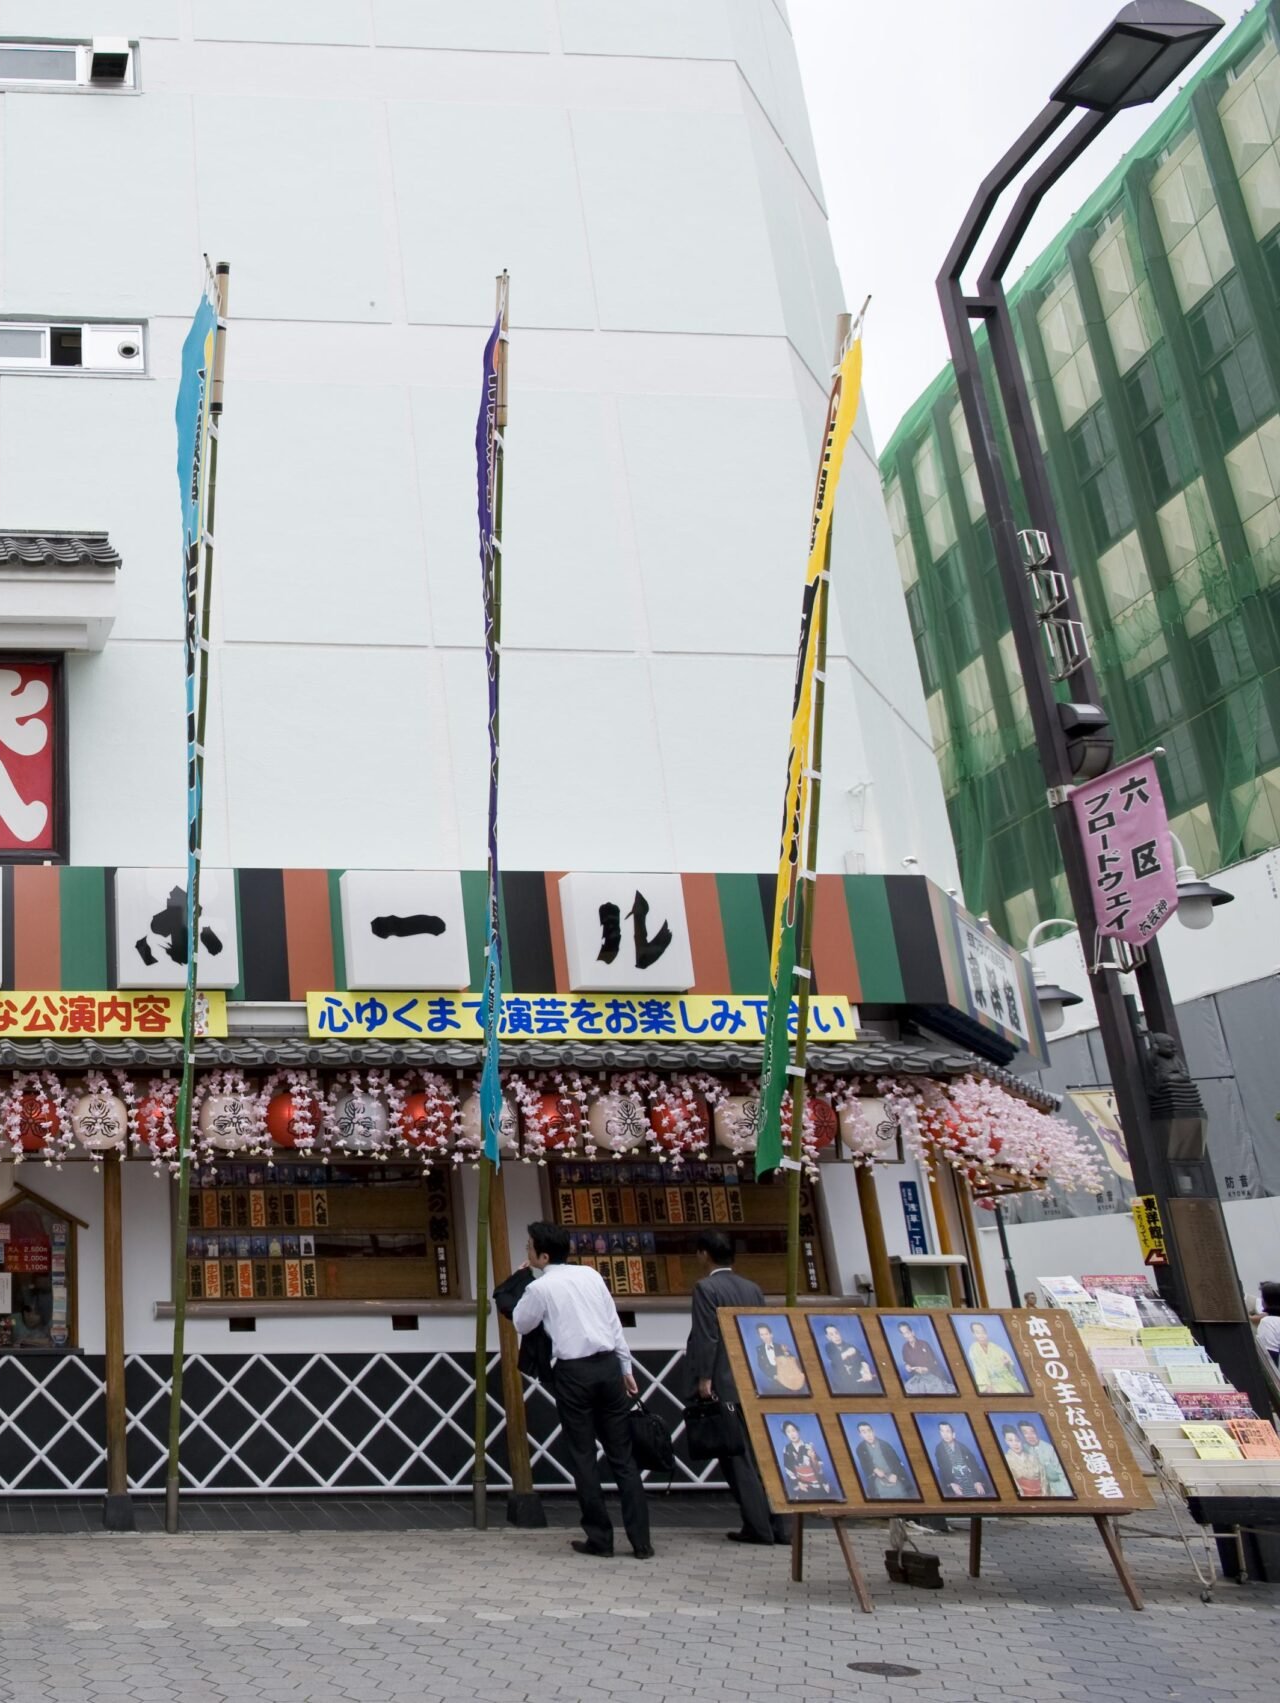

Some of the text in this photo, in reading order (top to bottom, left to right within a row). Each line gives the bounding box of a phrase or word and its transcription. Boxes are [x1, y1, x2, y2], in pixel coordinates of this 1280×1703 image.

[1119, 777, 1161, 879] 六区
[1025, 1314, 1125, 1500] 本日の主な出演者
